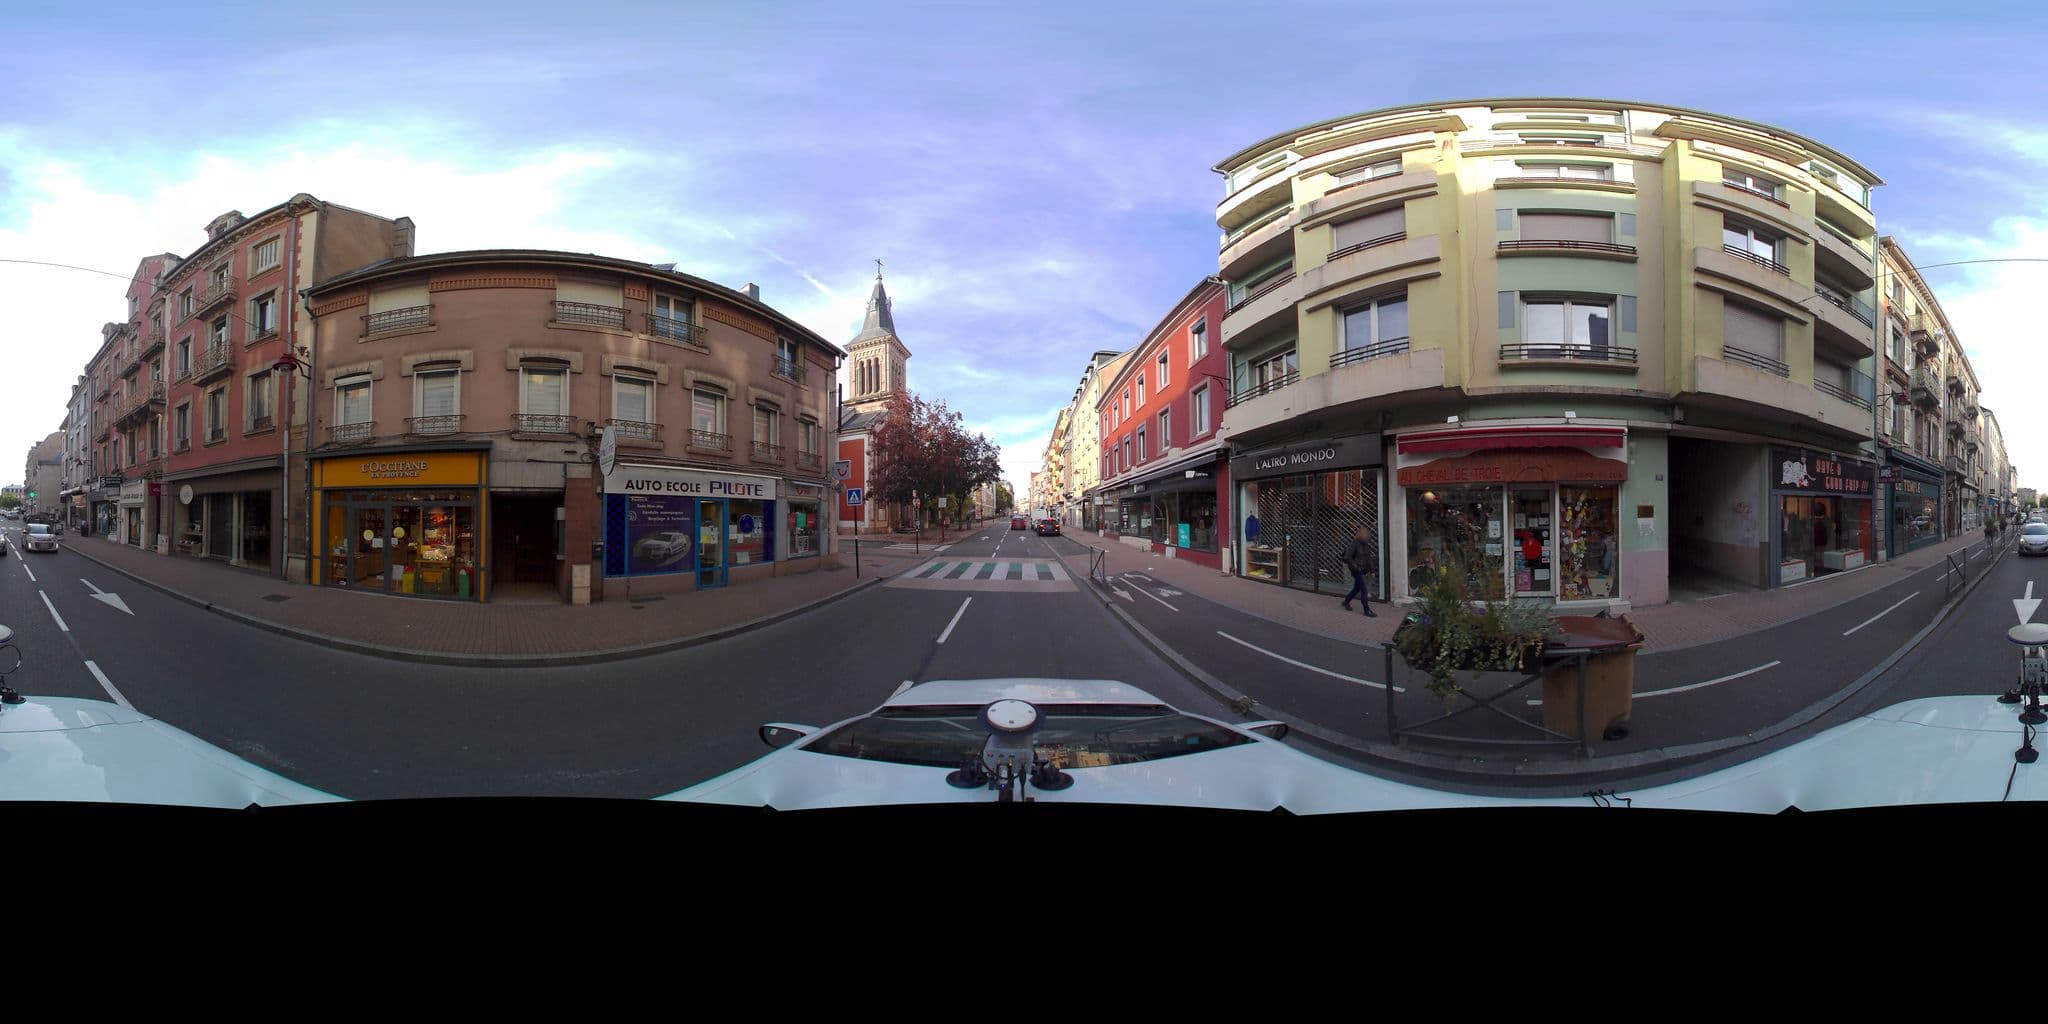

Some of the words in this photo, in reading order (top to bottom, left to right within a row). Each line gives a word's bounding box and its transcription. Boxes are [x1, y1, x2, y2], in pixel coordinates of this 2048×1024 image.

[360, 461, 429, 473] L'OCCITANE
[1255, 456, 1287, 470] L'ALTRO
[1291, 448, 1335, 465] MONDO
[625, 479, 662, 491] AUTO
[666, 481, 701, 493] ECOLE
[709, 480, 763, 496] PILOTE
